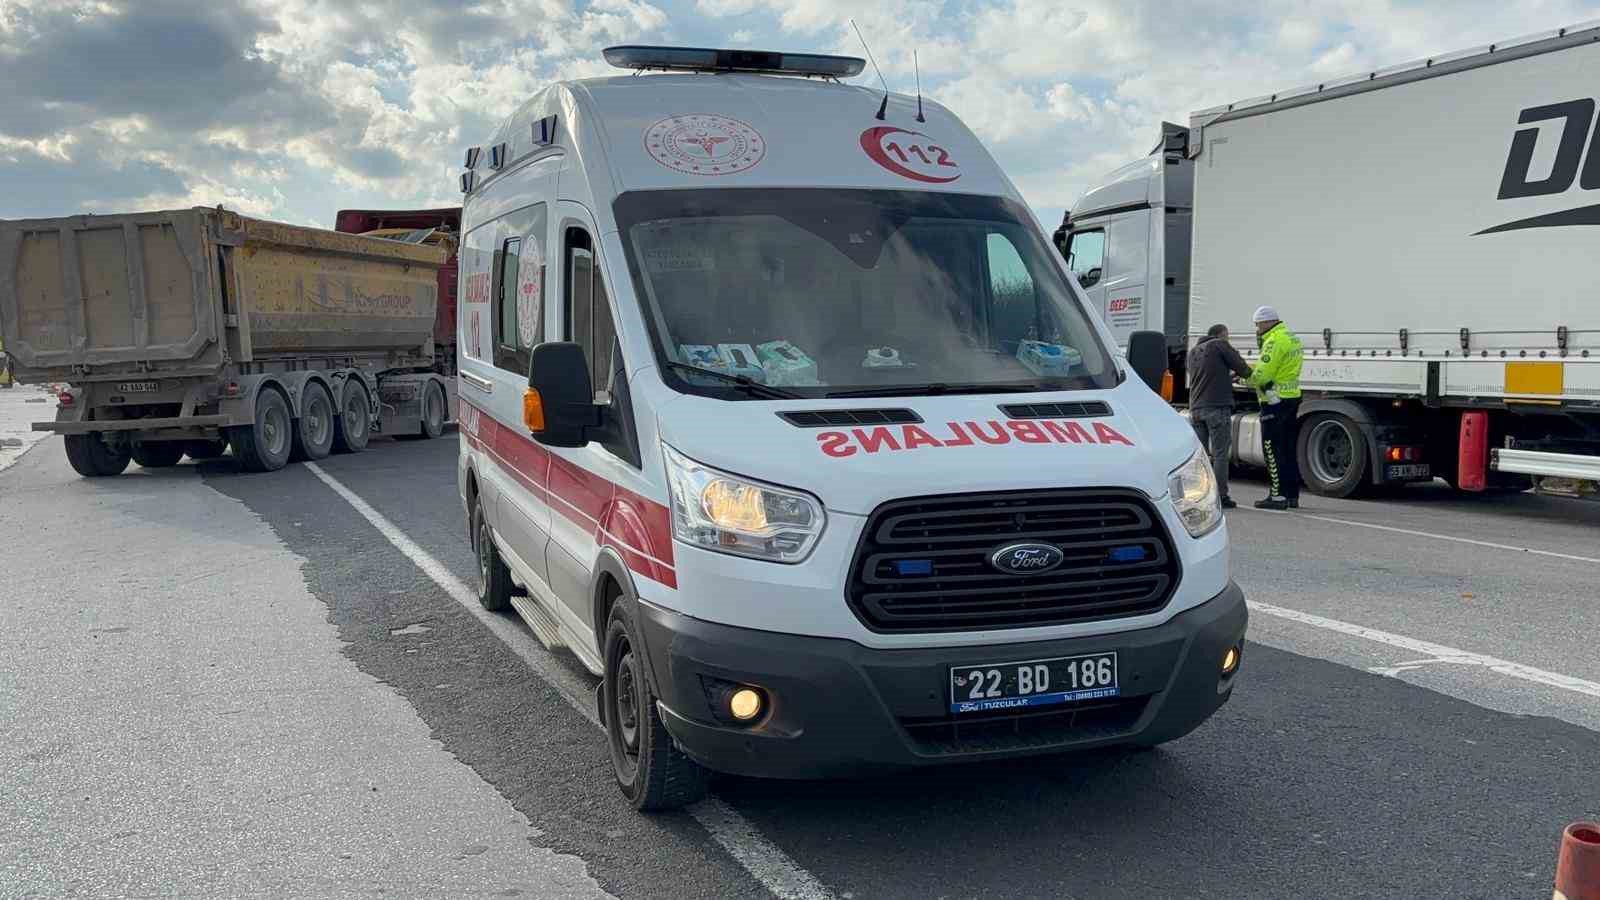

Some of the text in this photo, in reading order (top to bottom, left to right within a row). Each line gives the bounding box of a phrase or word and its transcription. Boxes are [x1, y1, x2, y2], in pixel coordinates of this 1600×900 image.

[886, 142, 958, 168] 112
[1496, 97, 1600, 200] D
[1010, 549, 1050, 569] Ford
[968, 657, 1112, 699] 22 BD 186
